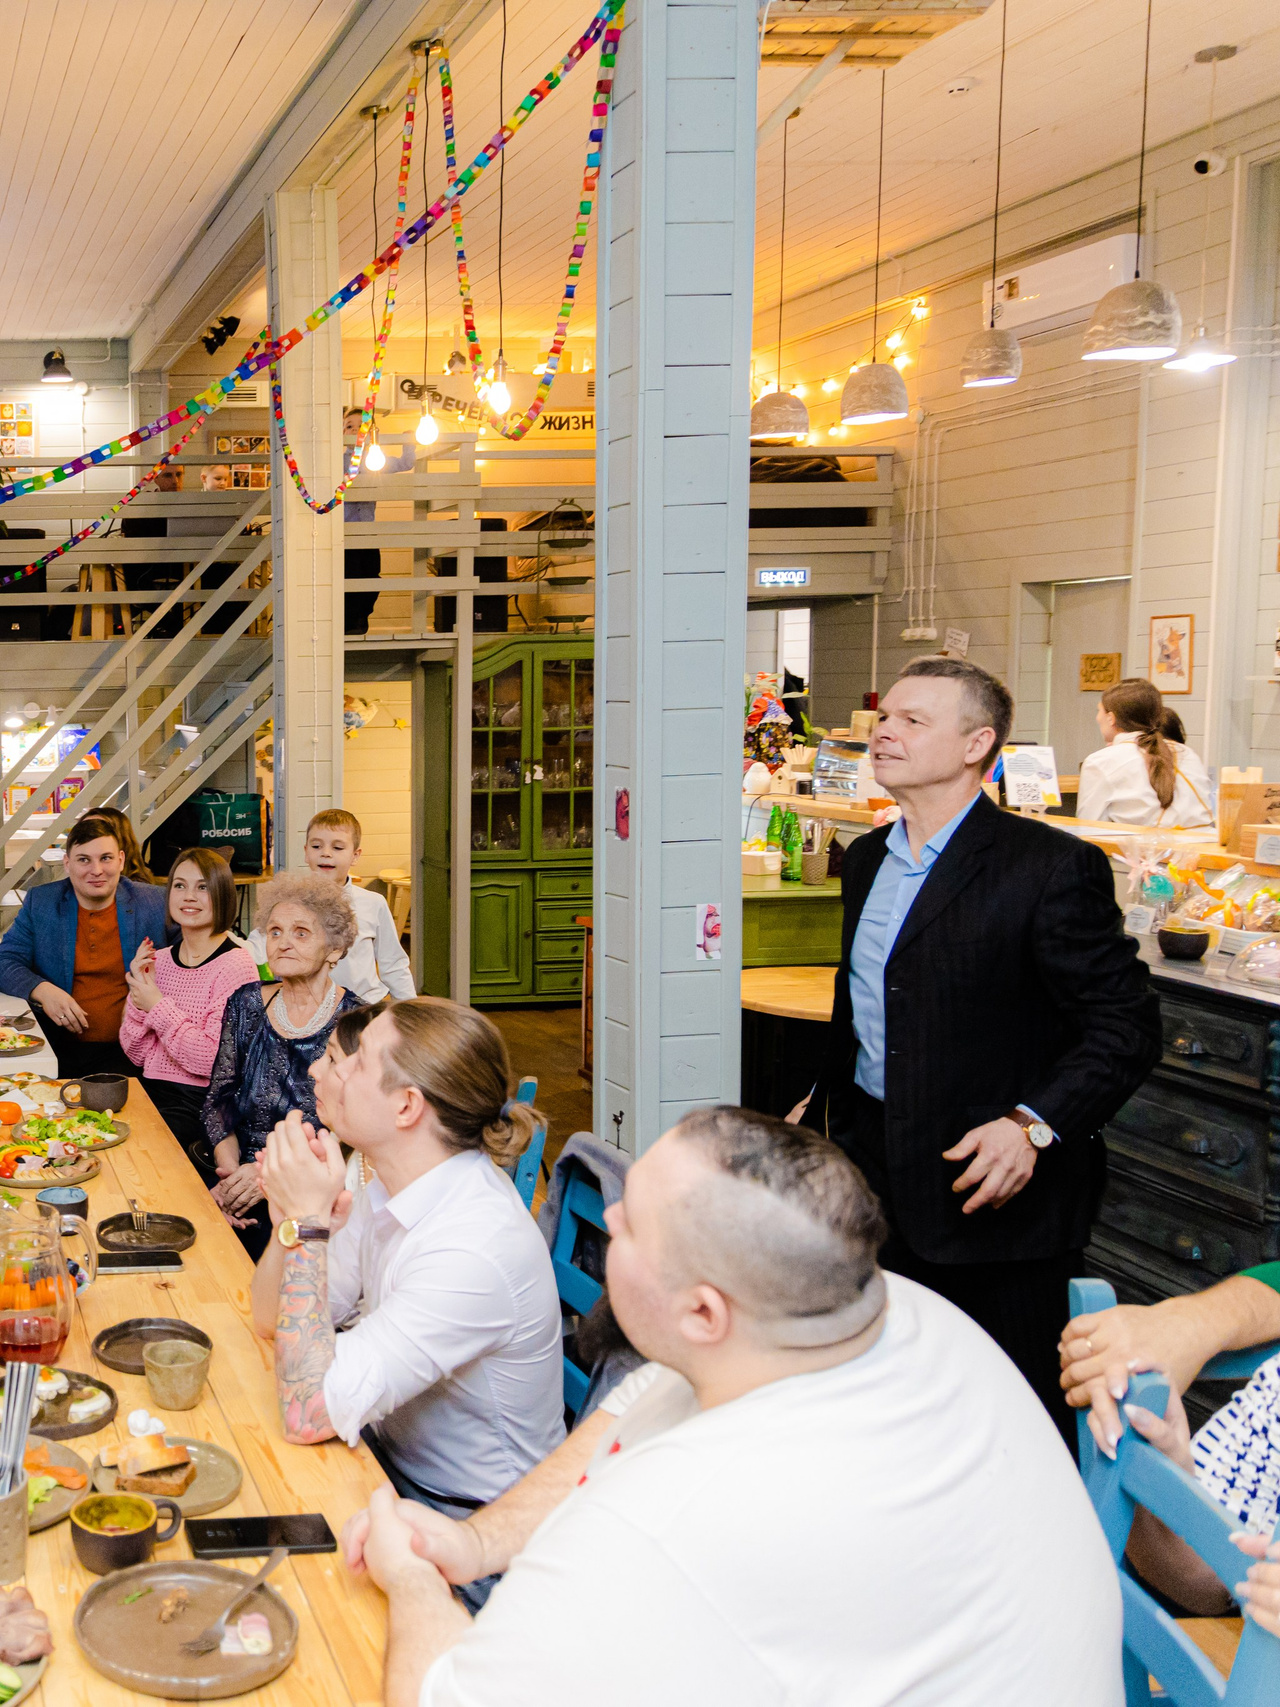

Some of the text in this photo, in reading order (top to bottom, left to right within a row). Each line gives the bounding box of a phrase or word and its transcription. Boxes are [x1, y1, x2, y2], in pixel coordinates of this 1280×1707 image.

[539, 415, 594, 430] ЖИЗН
[760, 571, 805, 582] ВЫХОД
[201, 828, 252, 838] РОБОСИБ
